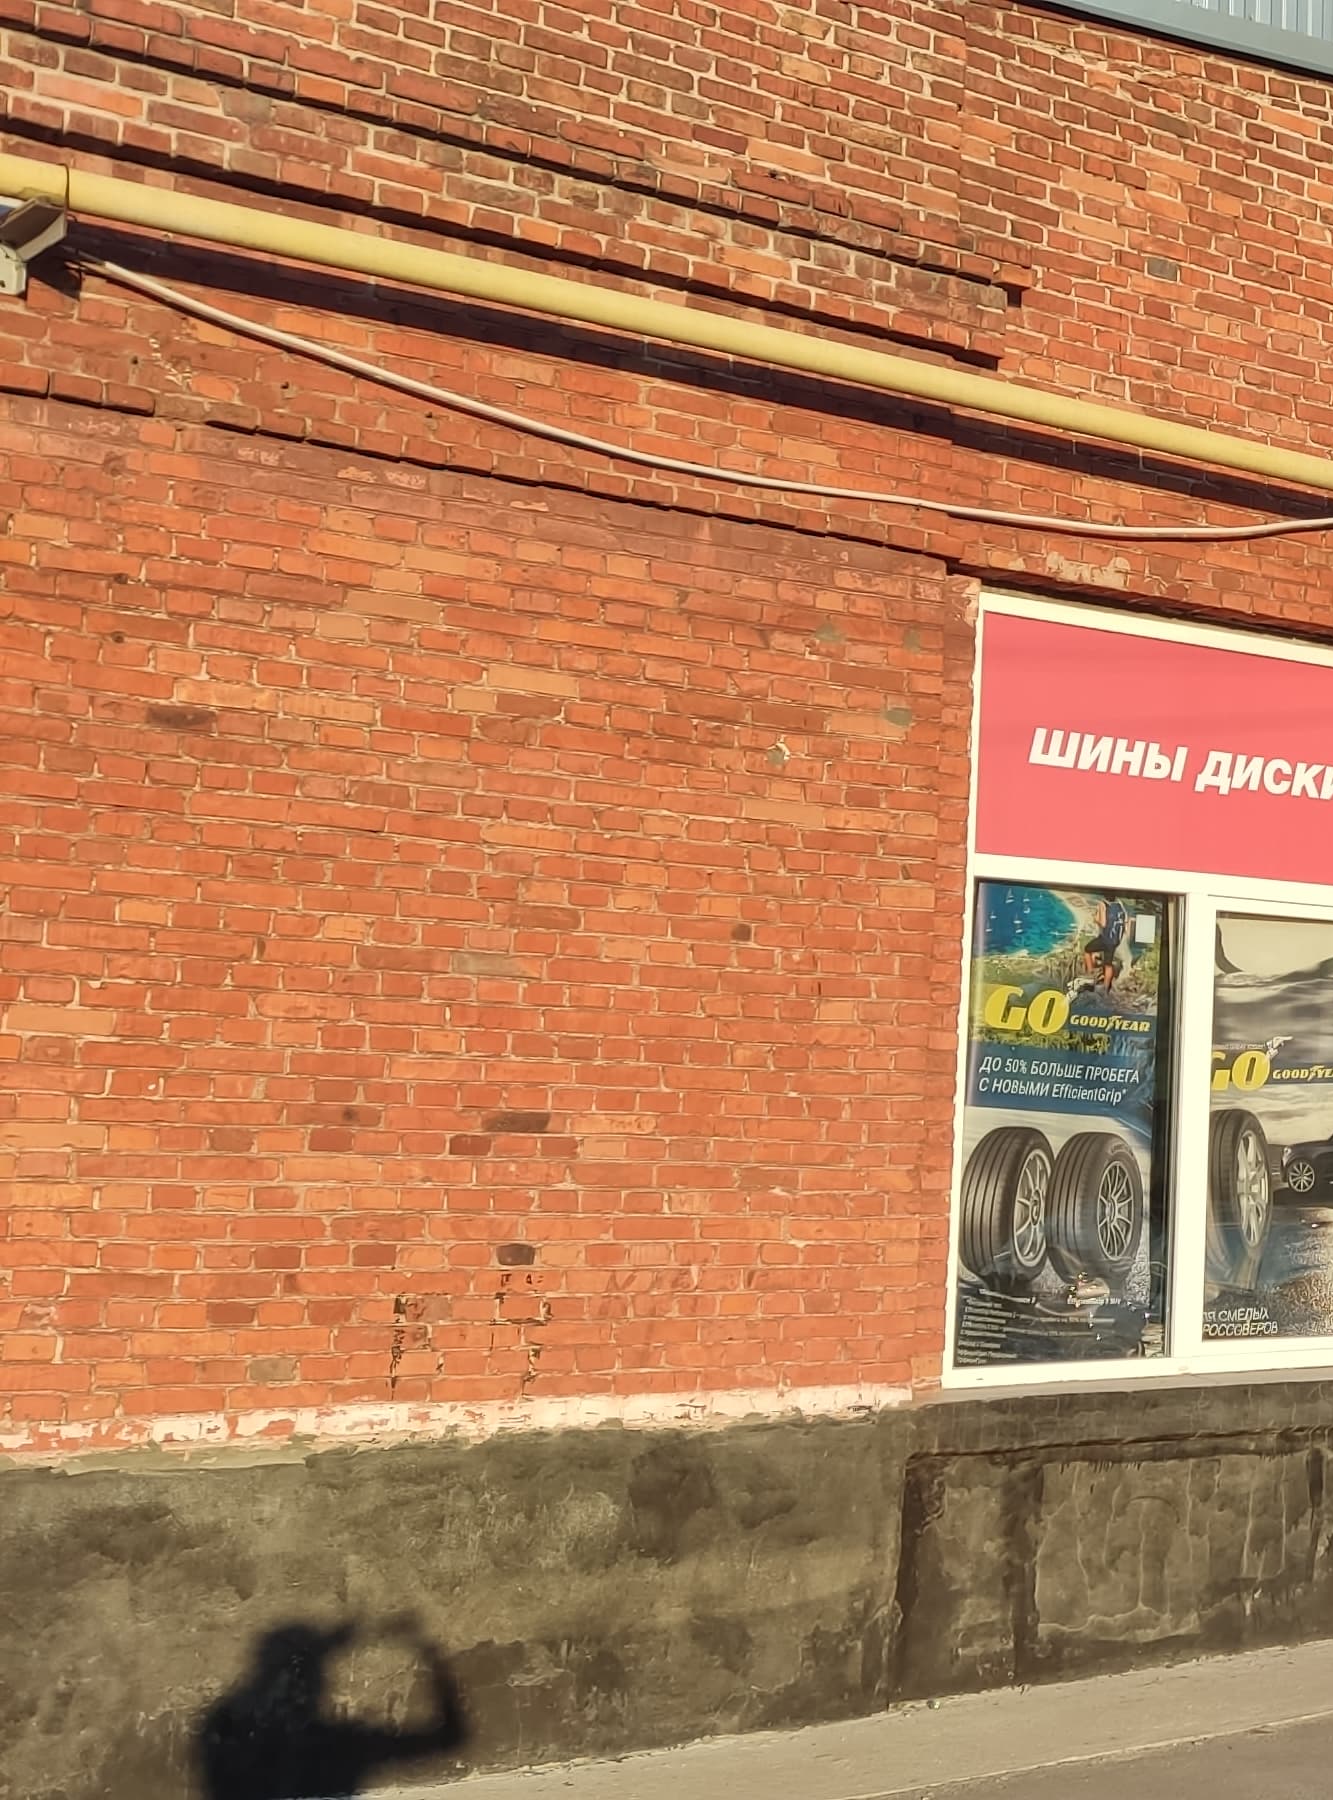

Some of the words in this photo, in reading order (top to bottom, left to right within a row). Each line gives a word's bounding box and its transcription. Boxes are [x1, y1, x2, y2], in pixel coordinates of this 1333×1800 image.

[1028, 728, 1189, 782] ШИНЫ
[985, 985, 1069, 1034] GO
[1070, 1015, 1151, 1032] GOODYEAR
[979, 1056, 1001, 1074] ДО
[1005, 1059, 1027, 1074] 50%
[1031, 1061, 1083, 1078] БОЛЬШЕ
[1085, 1066, 1140, 1084] ПРОБЕГА
[979, 1077, 989, 1091] С
[992, 1079, 1049, 1096] НОВЫМИ
[1218, 1307, 1269, 1321] СМЕЛЫХ
